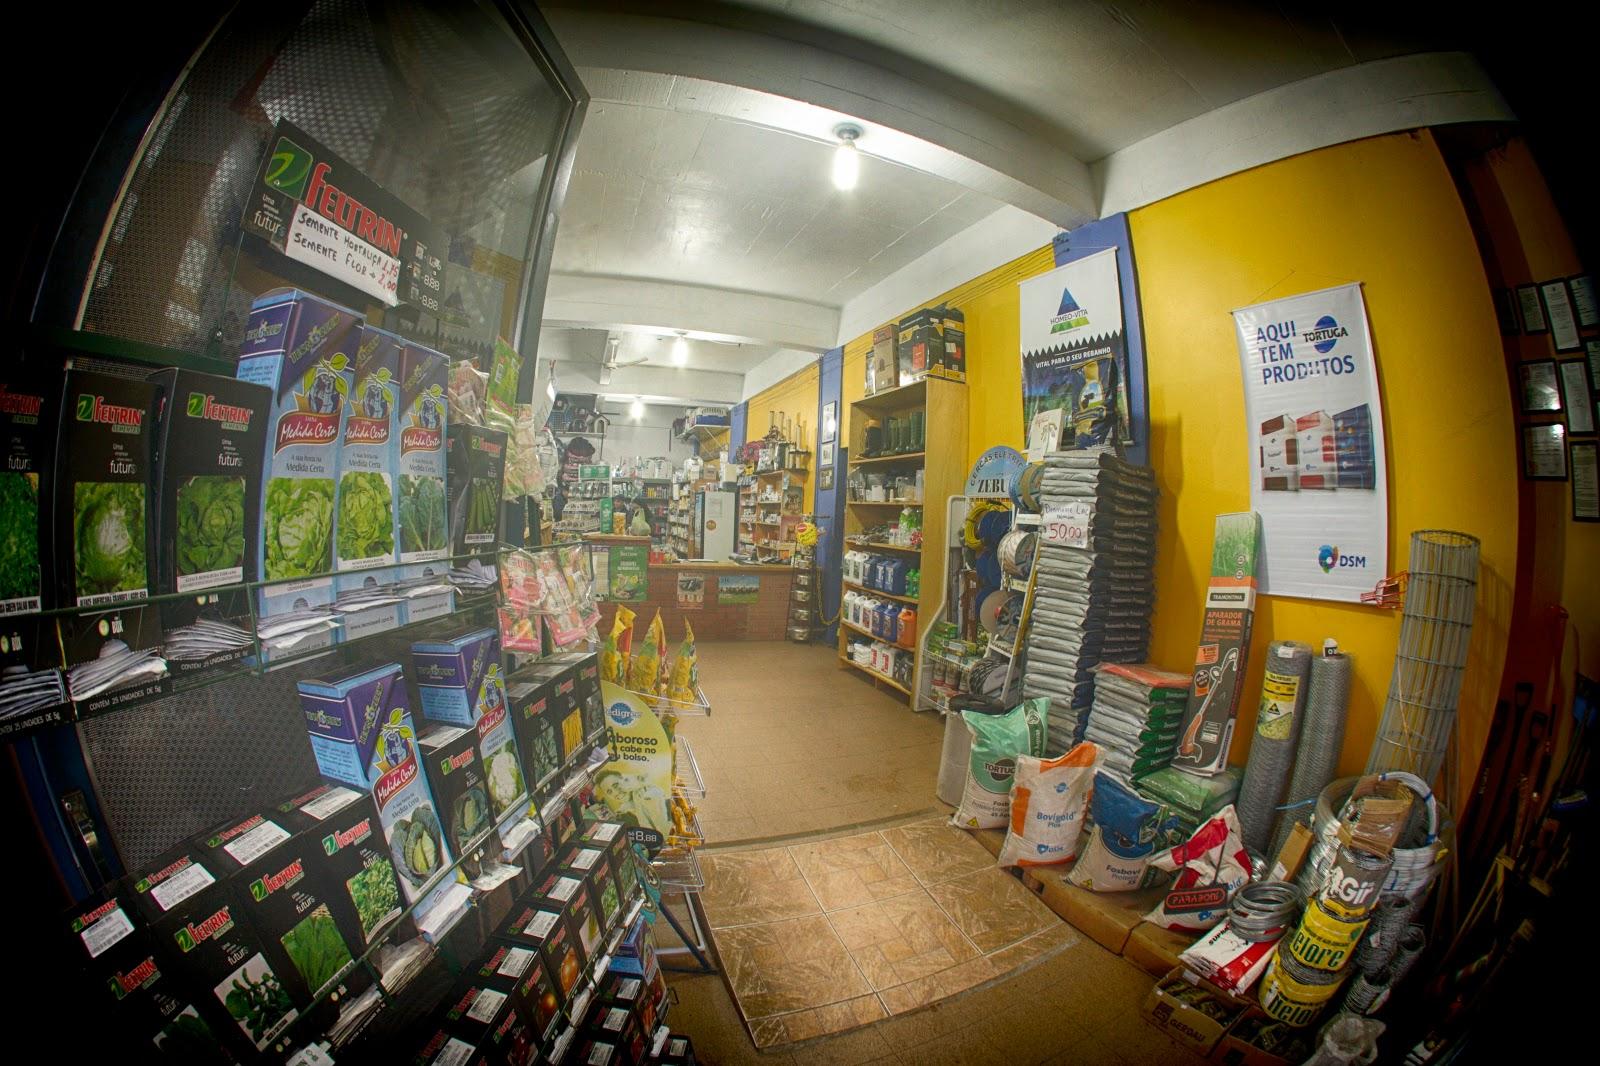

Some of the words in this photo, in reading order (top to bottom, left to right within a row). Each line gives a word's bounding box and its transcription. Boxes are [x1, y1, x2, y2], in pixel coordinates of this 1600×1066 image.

[298, 212, 339, 241] SEMENTE
[294, 232, 338, 262] SEMENTE
[1257, 320, 1297, 343] AQUI
[1302, 326, 1349, 343] TORTUGA
[1036, 358, 1051, 369] VITAL
[1050, 355, 1066, 367] PARA
[1071, 351, 1083, 361] SEU
[1258, 342, 1294, 364] TEM
[280, 420, 313, 442] Medida
[315, 422, 336, 439] Certa
[286, 463, 308, 472] Medida
[309, 464, 324, 473] Certa
[1340, 555, 1366, 568] DSM
[1206, 618, 1216, 626] DE
[120, 690, 145, 703] UNIDADES
[146, 687, 155, 696] DE
[45, 713, 53, 722] DE
[608, 733, 658, 747] aboroso
[620, 745, 642, 754] cabe
[644, 747, 657, 755] no
[623, 752, 650, 762] bolso.
[1037, 811, 1075, 823] Bovigold
